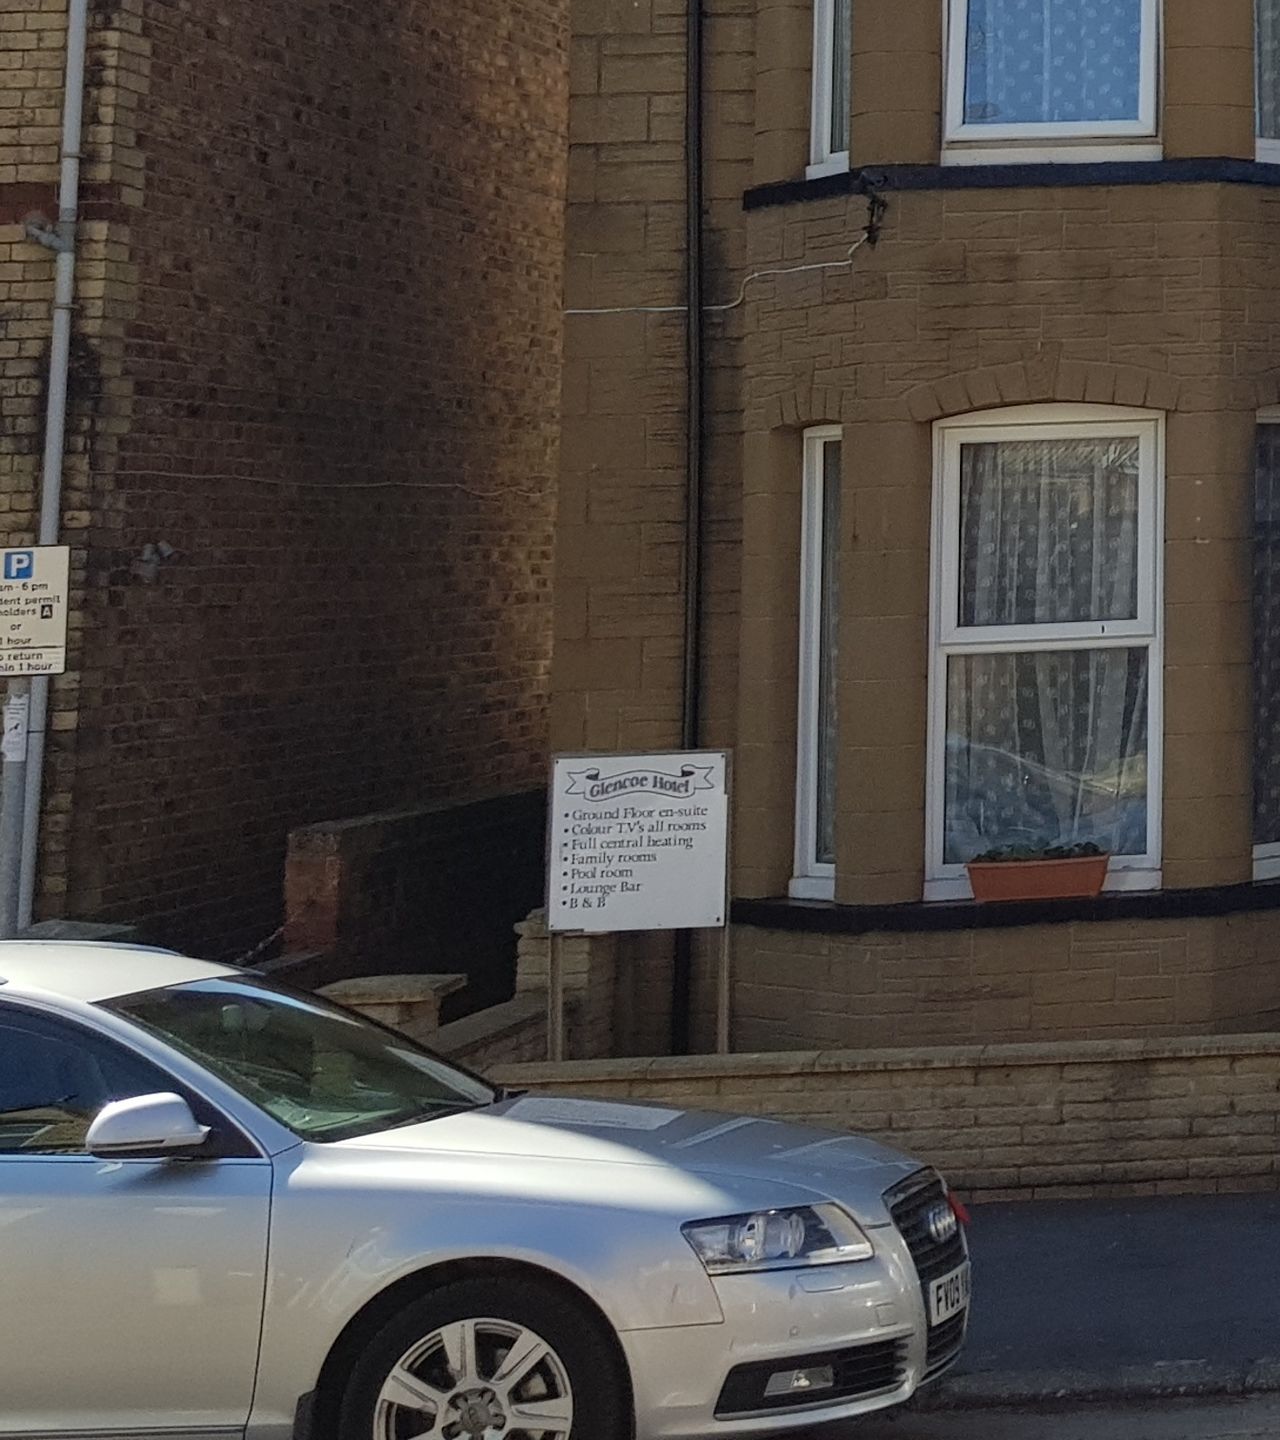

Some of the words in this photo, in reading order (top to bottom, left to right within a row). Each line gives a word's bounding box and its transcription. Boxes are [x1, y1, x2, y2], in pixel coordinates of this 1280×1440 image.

[10, 554, 30, 578] P
[22, 582, 29, 591] 6
[31, 583, 49, 592] pm
[25, 595, 61, 605] permit
[7, 636, 32, 645] hour
[8, 652, 43, 661] return
[27, 662, 53, 671] hour
[589, 776, 649, 798] Glencoe
[652, 775, 690, 794] Hotel
[571, 808, 620, 821] Ground
[623, 807, 655, 819] Floor
[658, 805, 709, 817] en-suite
[571, 823, 613, 835] Colour
[647, 820, 664, 833] all
[667, 821, 707, 832] rooms
[571, 837, 597, 850] Full
[600, 835, 643, 849] central
[647, 835, 694, 850] heating
[571, 852, 615, 868] Family
[618, 852, 657, 863] rooms
[571, 867, 597, 879] Pool
[600, 868, 633, 878] room
[570, 882, 617, 897] Lounge
[620, 881, 642, 892] Bar
[569, 897, 578, 909] B
[582, 897, 593, 908] &
[597, 896, 606, 908] B
